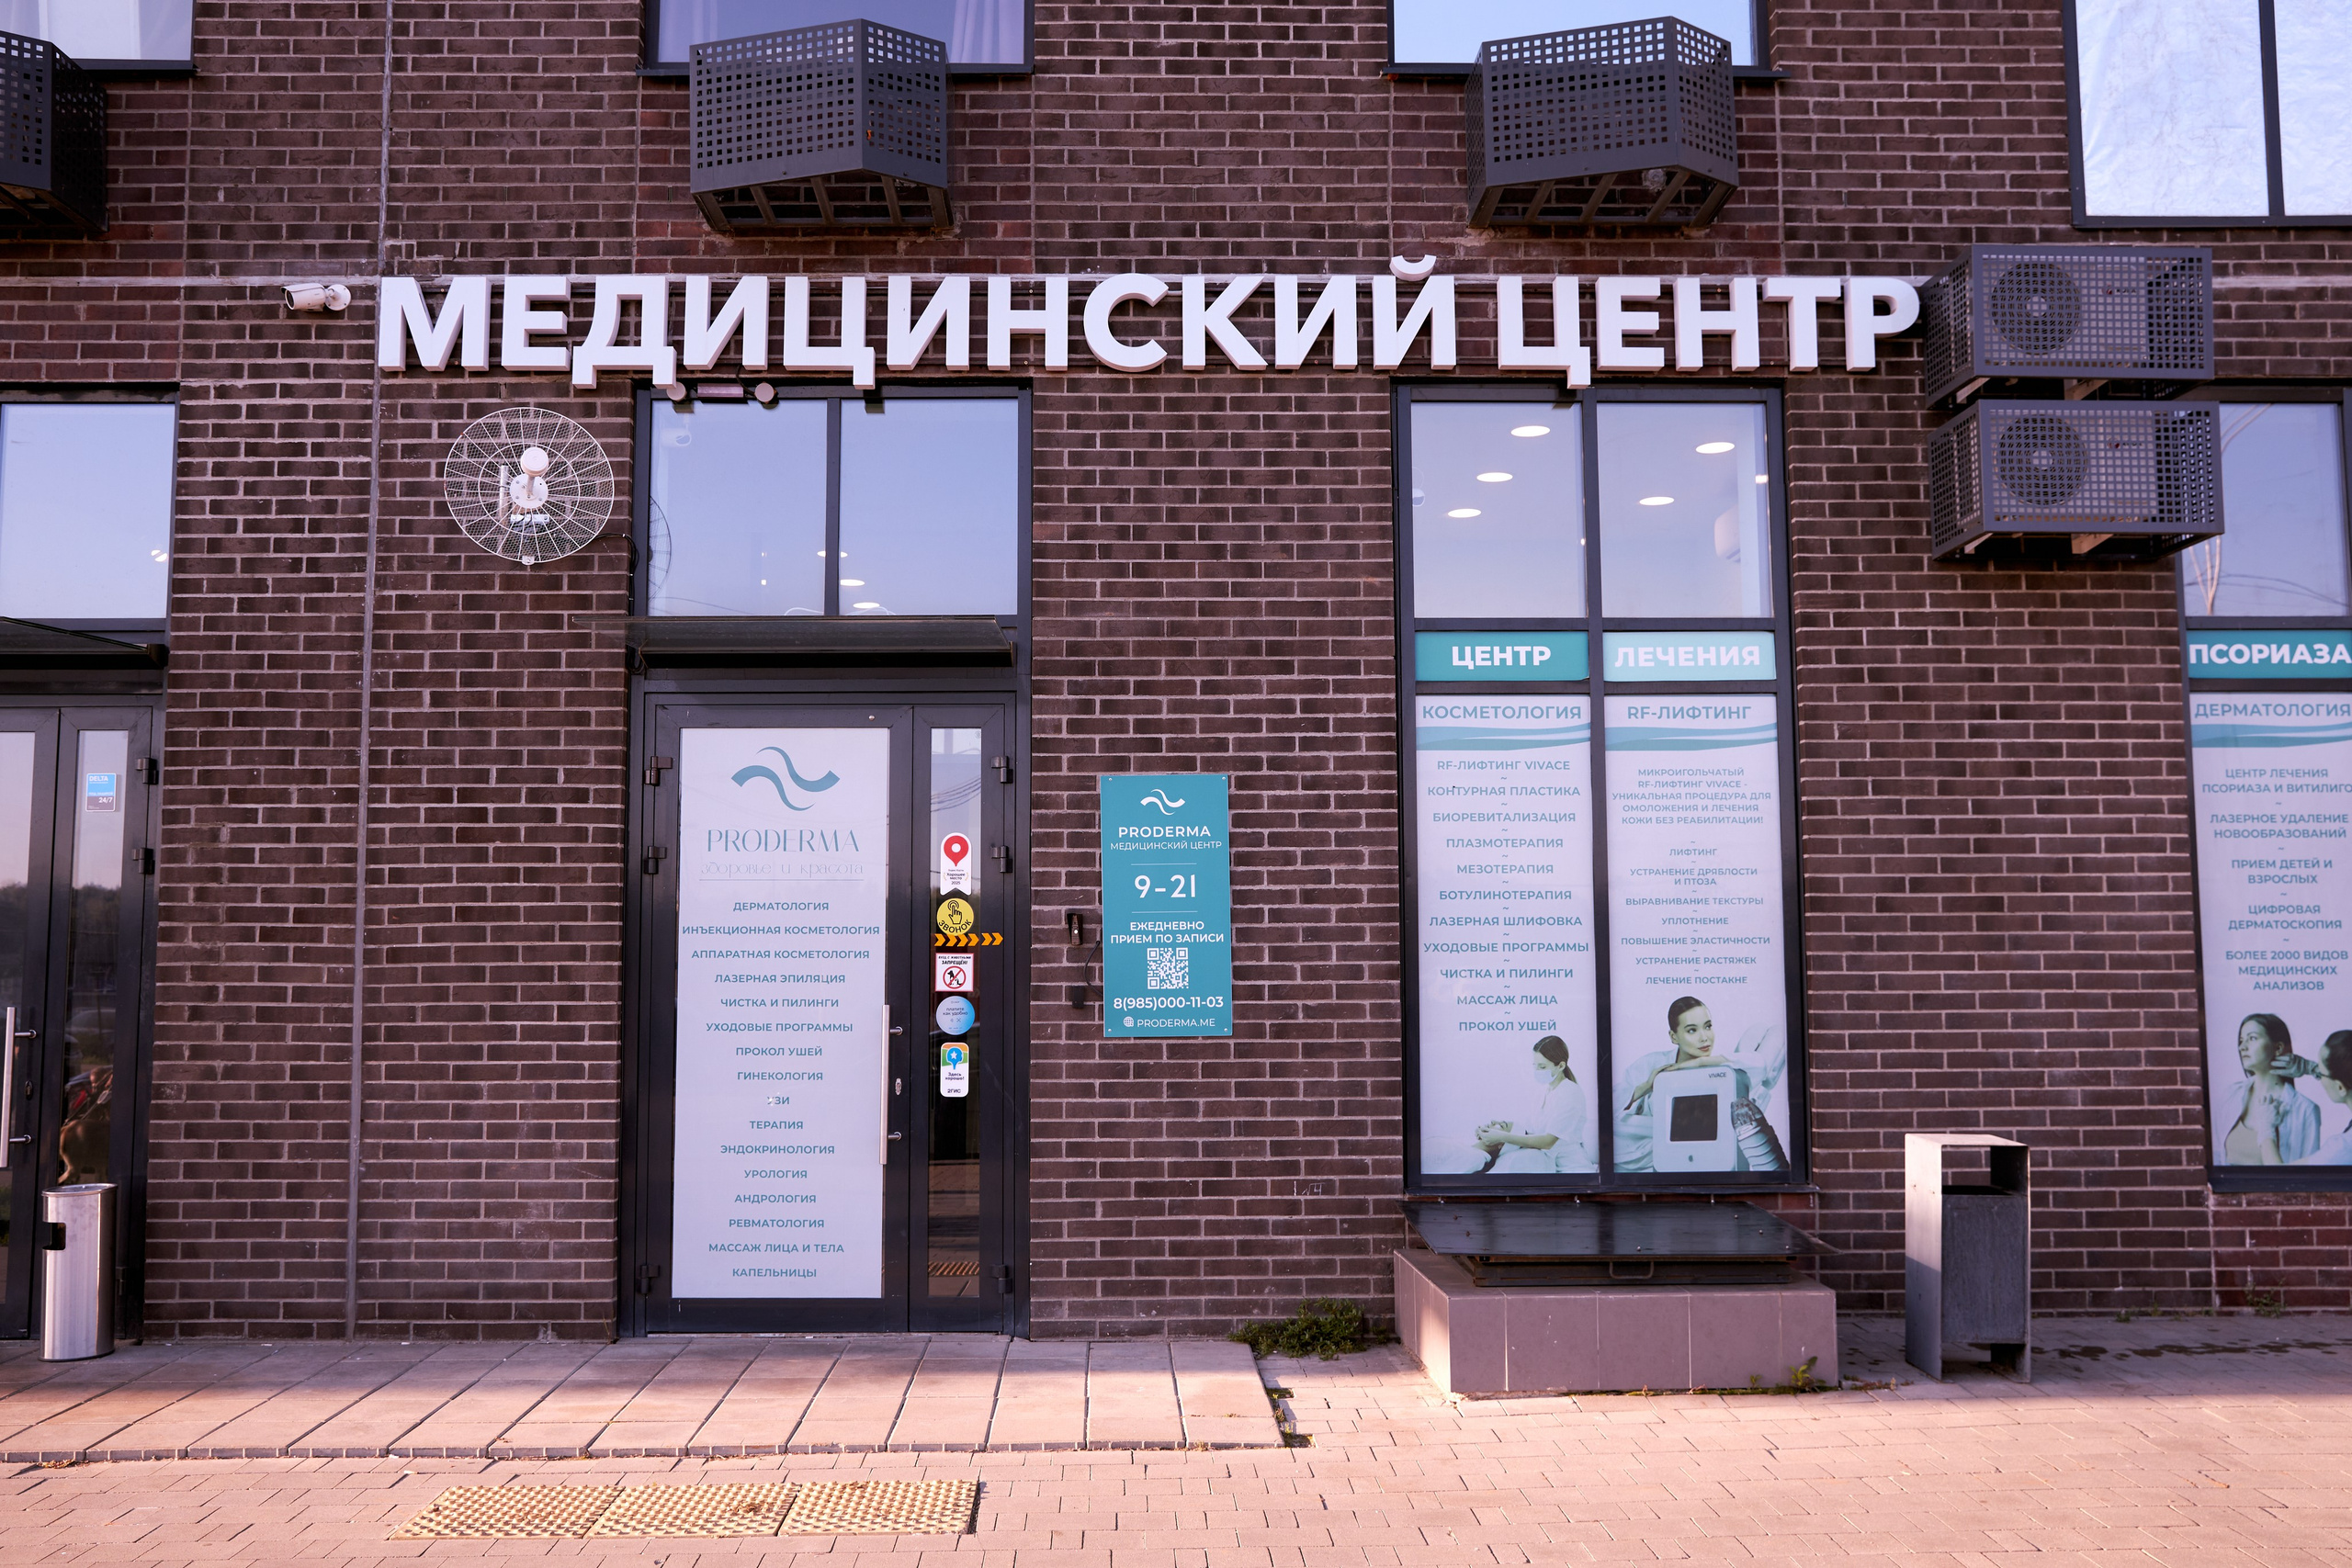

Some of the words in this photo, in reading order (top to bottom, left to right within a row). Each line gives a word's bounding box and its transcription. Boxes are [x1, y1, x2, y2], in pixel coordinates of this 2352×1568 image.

[375, 254, 1456, 389] МЕДИЦИНСКИЙ
[1497, 274, 1921, 389] ЦЕНТР
[1452, 646, 1551, 670] ЦЕНТР
[1614, 646, 1760, 668] ЛЕЧЕНИЯ
[2188, 643, 2352, 664] ПСОРИАЗА
[1422, 705, 1581, 719] КОСМЕТОЛОГИЯ
[1627, 705, 1751, 720] RF-ЛИФТИНГ
[2195, 704, 2351, 718] ДЕРМАТОЛОГИЯ
[1437, 761, 1521, 770] RF-ЛИФТИНГ
[1525, 761, 1570, 770] VIVACE
[1638, 768, 1745, 776] МИКРОИГОЛЬЧАТЫЙ
[2225, 769, 2267, 779] ЦЕНТР
[2269, 769, 2328, 778] ЛЕЧЕНИЯ
[1428, 786, 1506, 795] КОНТУРНАЯ
[1510, 786, 1580, 795] ПЛАСТИКА
[2202, 784, 2269, 793] ПСОРИАЗА
[2275, 784, 2282, 793] И
[2287, 784, 2352, 793] ВИТИЛИГО
[1685, 793, 1747, 801] ПРОЦЕДУРА
[1750, 793, 1771, 801] ДЛЯ
[1433, 812, 1576, 823] БИОРЕВИТАЛИЗАЦИЯ
[1622, 817, 1652, 825] КОЖИ
[1677, 817, 1764, 825] РЕАБИЛИТАЦИИ!
[2211, 815, 2277, 824] ЛАЗЕРНОЕ
[2280, 815, 2349, 825] УДАЛЕНИЕ
[1118, 826, 1211, 839] PRODERMA
[2214, 827, 2346, 839] НОВООБРАЗОВАНИЙ
[707, 829, 860, 852] PRODERMA
[1110, 840, 1187, 851] МЕДИЦИНСКИЙ
[1190, 841, 1222, 851] ЦЕНТР
[1446, 839, 1563, 848] ПЛАЗМОТЕРАПИЯ
[1669, 848, 1717, 856] ЛИФТИНГ
[2232, 860, 2276, 869] ПРИЕМ
[2279, 857, 2320, 870] ДЕТЕЙ
[2324, 860, 2333, 868] И
[701, 862, 772, 878] здоровье
[781, 863, 791, 874] и
[800, 863, 864, 878] красота
[1457, 864, 1554, 874] МЕЗОТЕРАПИЯ
[1630, 868, 1695, 876] УСТРАНЕНИЕ
[1697, 868, 1758, 877] ДРЯБЛОСТИ
[2248, 874, 2318, 884] ВЗРОСЛЫХ
[1440, 890, 1572, 900] БОТУЛИНОТЕРАПИЯ
[1626, 897, 1710, 906] ВЫРАВНИВАНИЕ
[732, 902, 830, 912] ДЕРМАТОЛОГИЯ
[2248, 905, 2321, 915] ЦИФРОВАЯ
[939, 919, 971, 933] ЗВОНОК
[1130, 920, 1204, 932] ЕЖЕДНЕВНО
[1430, 917, 1499, 927] ЛАЗЕРНАЯ
[1504, 917, 1582, 926] ШЛИФОВКА
[1661, 917, 1729, 925] УПЛОТНЕНИЕ
[2228, 919, 2342, 931] ДЕРМАТОСКОПИЯ
[682, 926, 781, 936] ИНЪЕКЦИОННАЯ
[785, 926, 880, 935] КОСМЕТОЛОГИЯ
[1111, 934, 1152, 944] ПРИЕМ
[1156, 934, 1172, 943] ПО
[1176, 933, 1224, 943] ЗАПИСИ
[1622, 937, 1688, 945] ПОВЫШЕНИЕ
[1690, 937, 1770, 945] ЭЛАСТИЧНОСТИ
[1424, 942, 1498, 953] УХОДОВЫЕ
[1502, 942, 1589, 953] ПРОГРАММЫ
[692, 950, 771, 959] АППАРАТНАЯ
[775, 950, 869, 959] КОСМЕТОЛОГИЯ
[2226, 951, 2267, 960] БОЛЕЕ
[2271, 951, 2300, 960] 2000
[2304, 951, 2348, 961] ВИДОВ
[1703, 956, 1757, 964] РАСТЯЖЕК
[1441, 969, 1492, 978] ЧИСТКА
[1497, 969, 1505, 978] И
[1510, 969, 1573, 978] ПИЛИНГИ
[2238, 966, 2337, 976] МЕДИЦИНСКИХ
[715, 975, 777, 983] ЛАЗЕРНАЯ
[780, 974, 845, 985] ЭПИЛЯЦИЯ
[1645, 976, 1691, 985] ЛЕЧЕНИЕ
[2253, 981, 2324, 990] АНАЛИЗОВ
[720, 998, 767, 1008] ЧИСТКА
[771, 998, 778, 1007] И
[782, 998, 839, 1008] ПИЛИНГИ
[1114, 996, 1224, 1011] 8(985)000-11-03
[1457, 996, 1516, 1005] МАССАЖ
[1520, 995, 1557, 1006] ЛИЦА
[706, 1022, 773, 1033] УХОДОВЫЕ
[775, 1022, 853, 1032] ПРОГРАММЫ
[1137, 1018, 1216, 1028] PRODERMA.ME
[1459, 1021, 1514, 1032] ПРОКОЛ
[1518, 1019, 1556, 1031] УШЕЙ
[735, 1047, 786, 1056] ПРОКОЛ
[788, 1044, 822, 1056] УШЕЙ
[737, 1072, 823, 1081] ГИНЕКОЛОГИЯ
[750, 1121, 804, 1130] ТЕРАПИЯ
[720, 1145, 835, 1156] ЭНДОКРИНОЛОГИЯ
[744, 1169, 808, 1179] УРОЛОГИЯ
[734, 1194, 817, 1204] АНДРОЛОГИЯ
[729, 1219, 825, 1228] РЕВМАТОЛОГИЯ
[708, 1244, 762, 1253] МАССАЖ
[764, 1244, 798, 1254] ЛИЦА
[802, 1244, 810, 1253] И
[814, 1244, 844, 1253] ТЕЛА
[732, 1269, 817, 1279] КАПЕЛЬНИЦЫ
